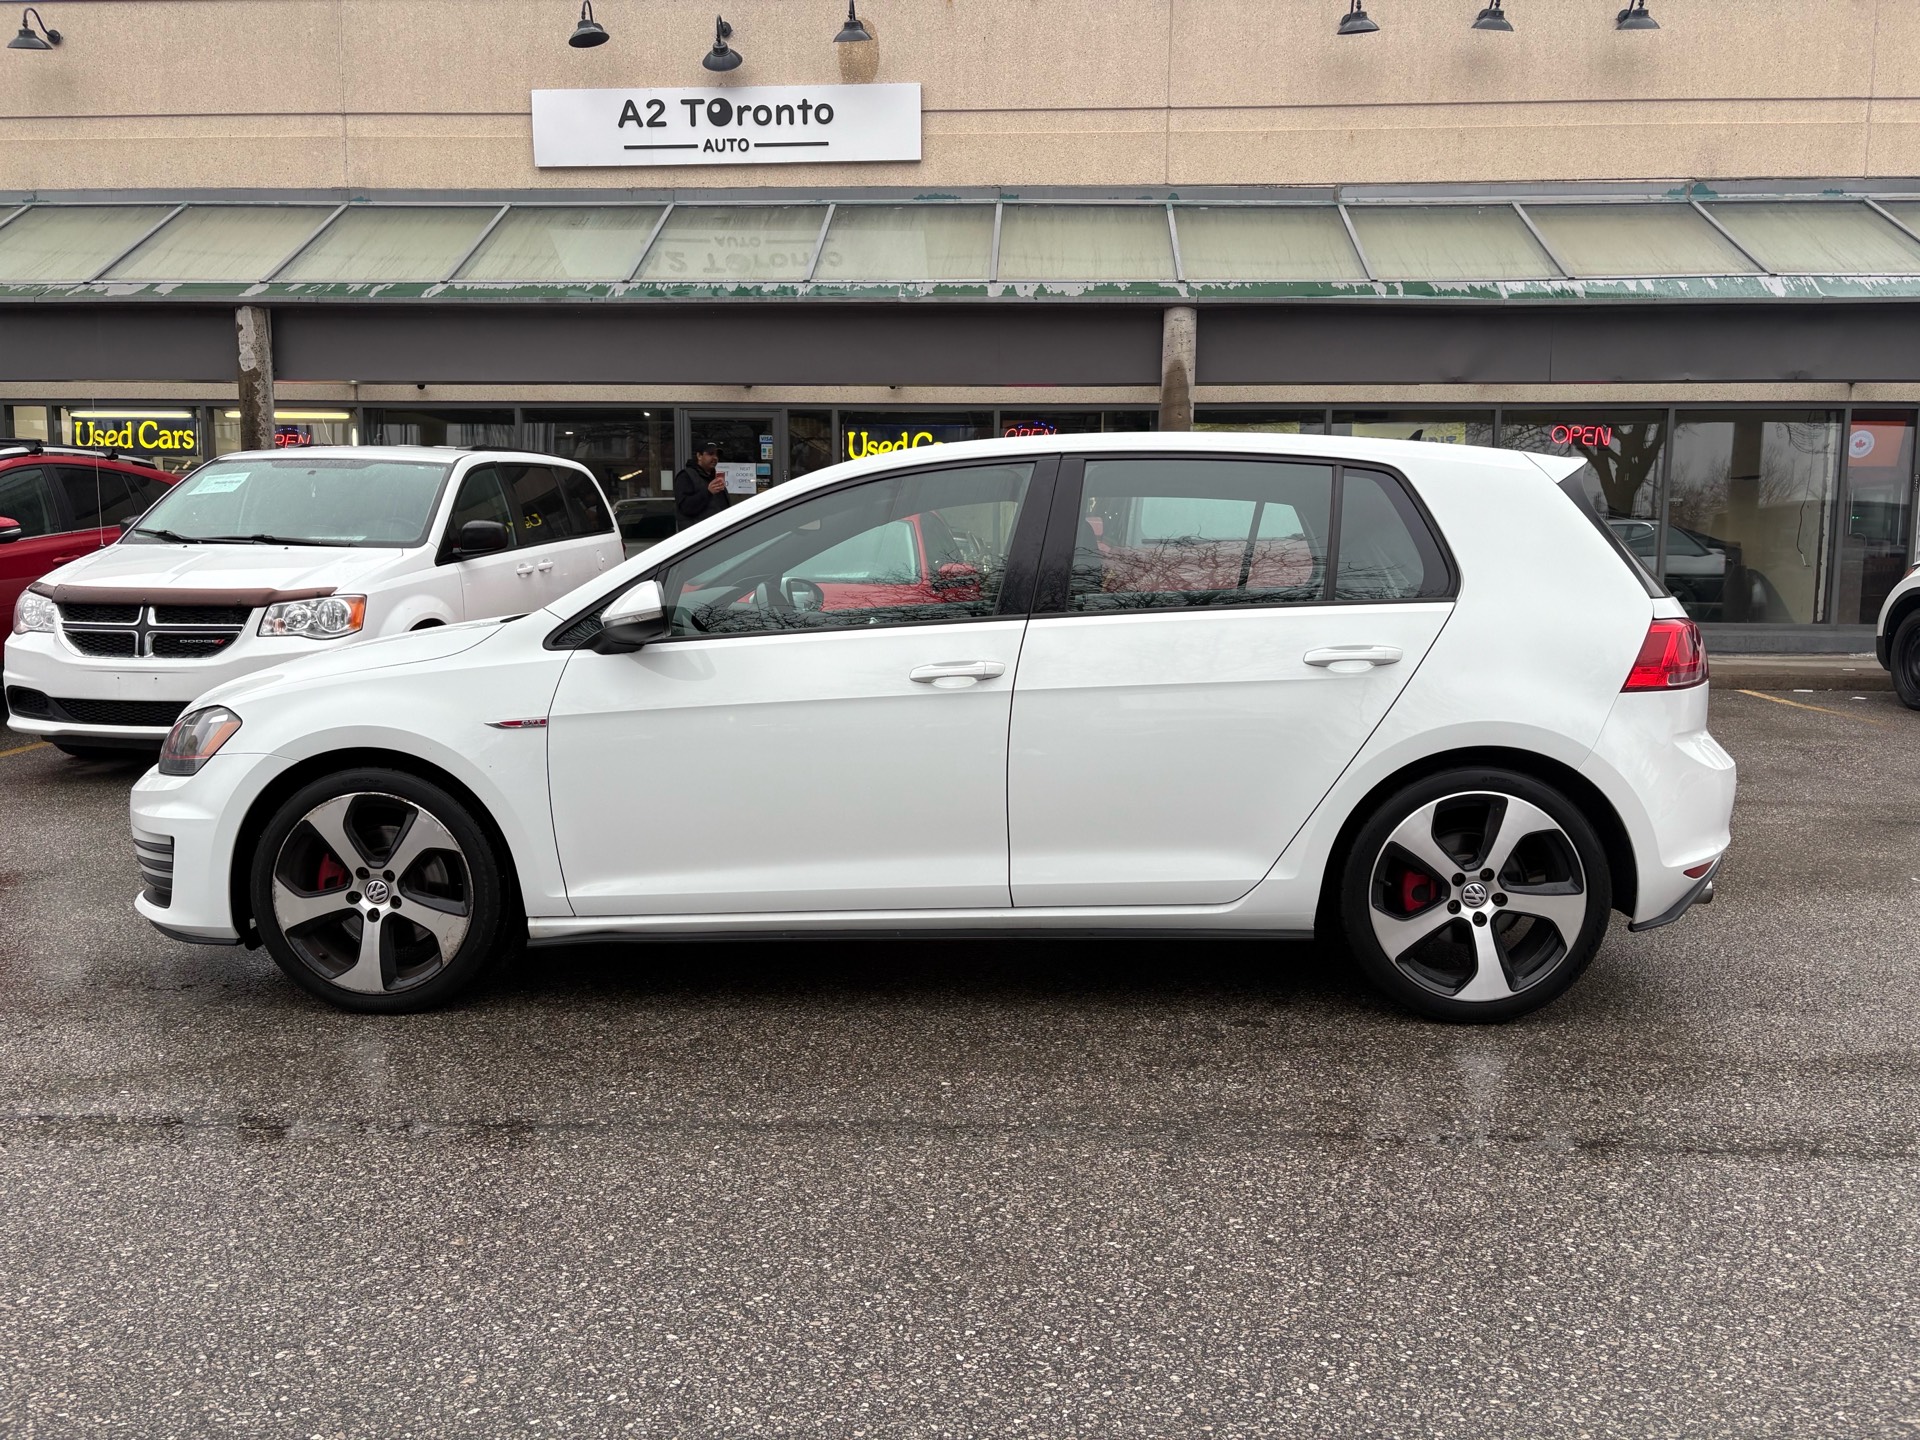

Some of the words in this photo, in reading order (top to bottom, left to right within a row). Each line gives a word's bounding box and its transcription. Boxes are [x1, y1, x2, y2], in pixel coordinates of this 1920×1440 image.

[617, 98, 667, 128] A2
[702, 137, 750, 153] AUTO
[75, 421, 134, 449] Used
[138, 420, 195, 449] Cars
[274, 434, 311, 449] PEN
[847, 431, 908, 460] Used
[1551, 425, 1612, 447] OPEN
